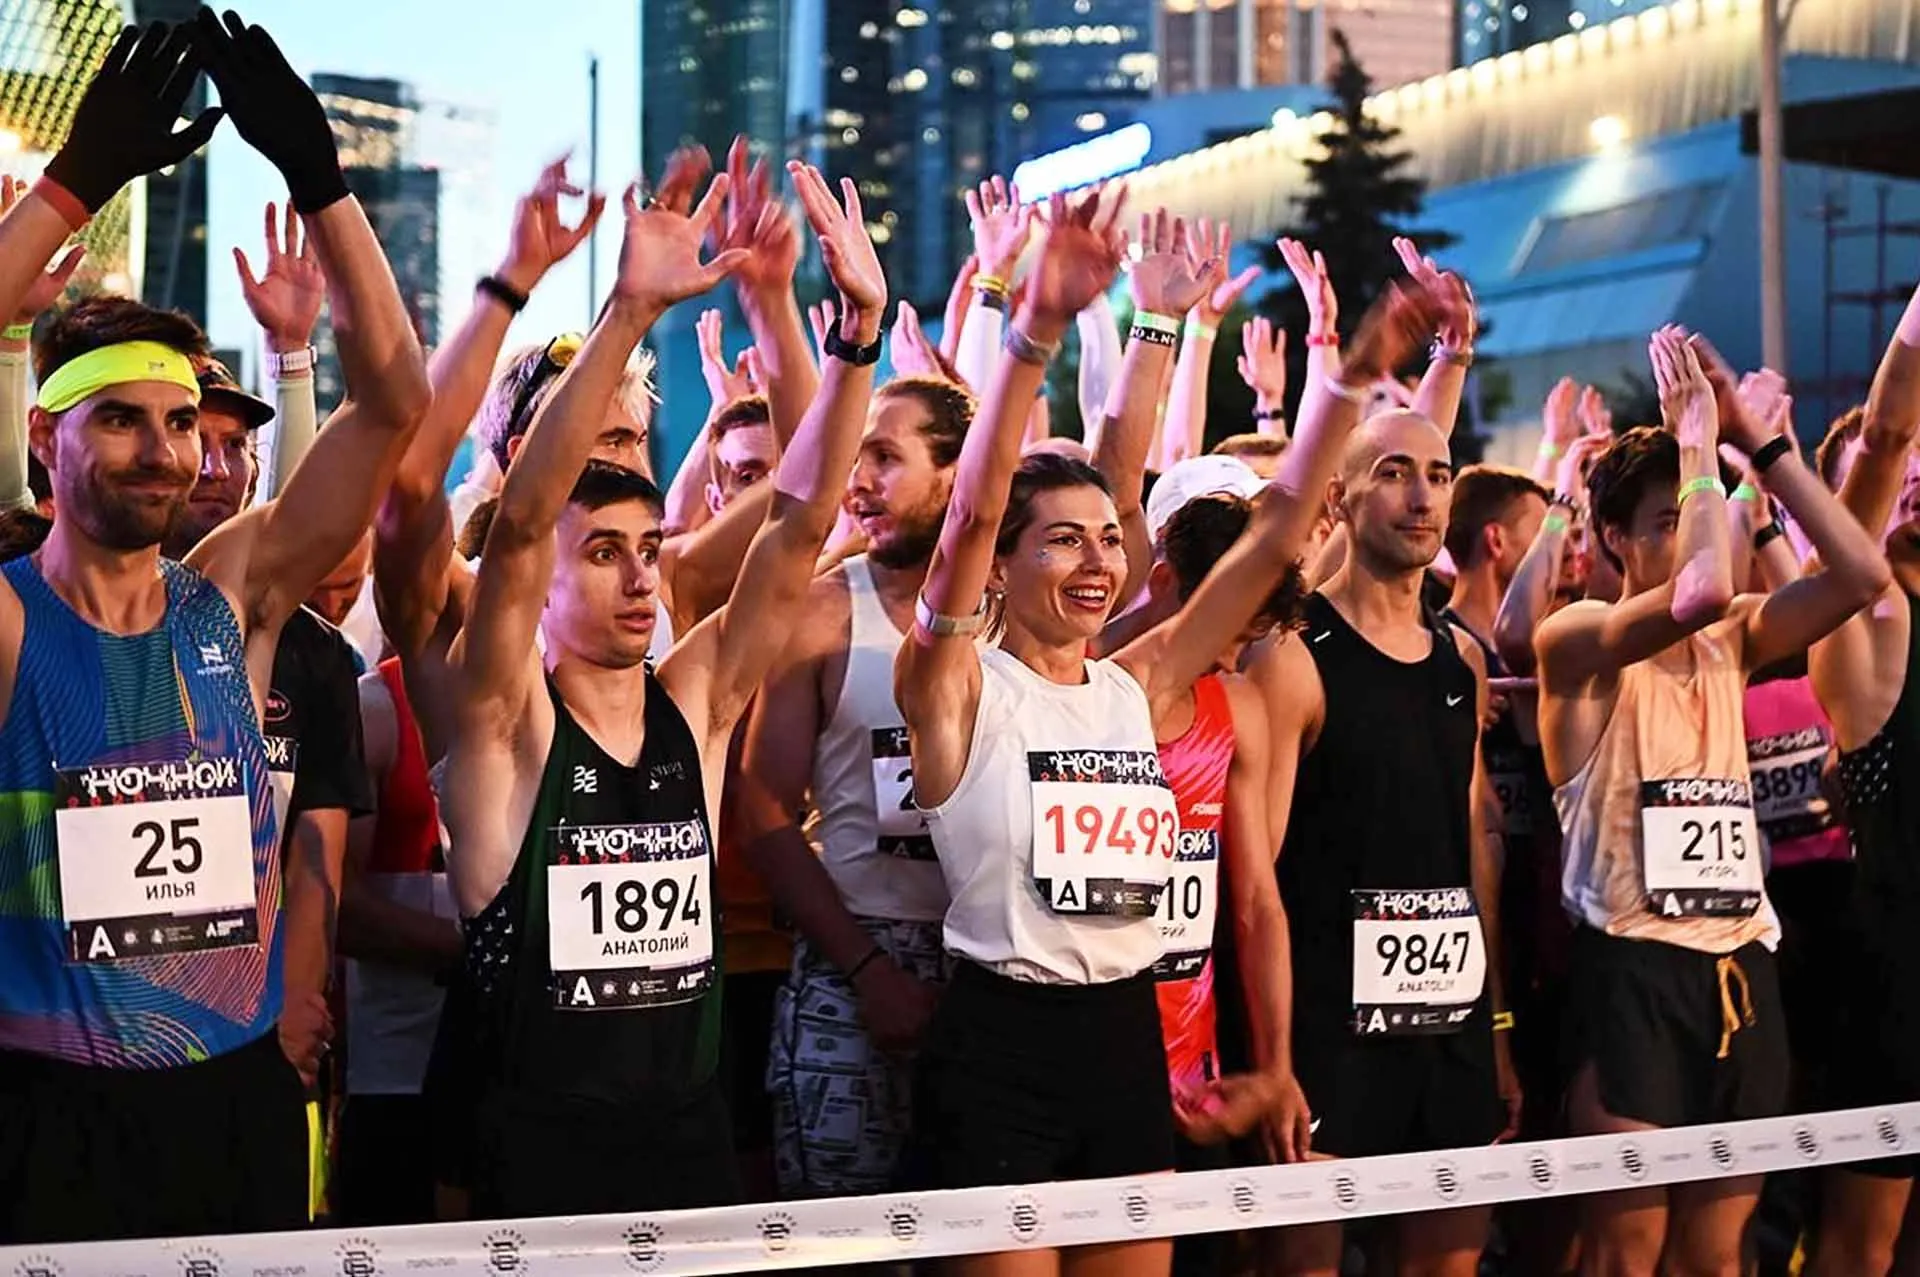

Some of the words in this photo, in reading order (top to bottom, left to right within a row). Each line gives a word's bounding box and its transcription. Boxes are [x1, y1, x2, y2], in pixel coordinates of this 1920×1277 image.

[80, 757, 237, 797] НОЧНОЙ
[131, 817, 203, 879] 25
[1044, 804, 1176, 860] 19493
[1681, 820, 1746, 861] 215
[145, 882, 197, 901] ИЛЬЯ
[580, 874, 701, 935] 1894
[601, 932, 689, 956] АНАТОЛИЙ
[1376, 930, 1470, 977] 9847
